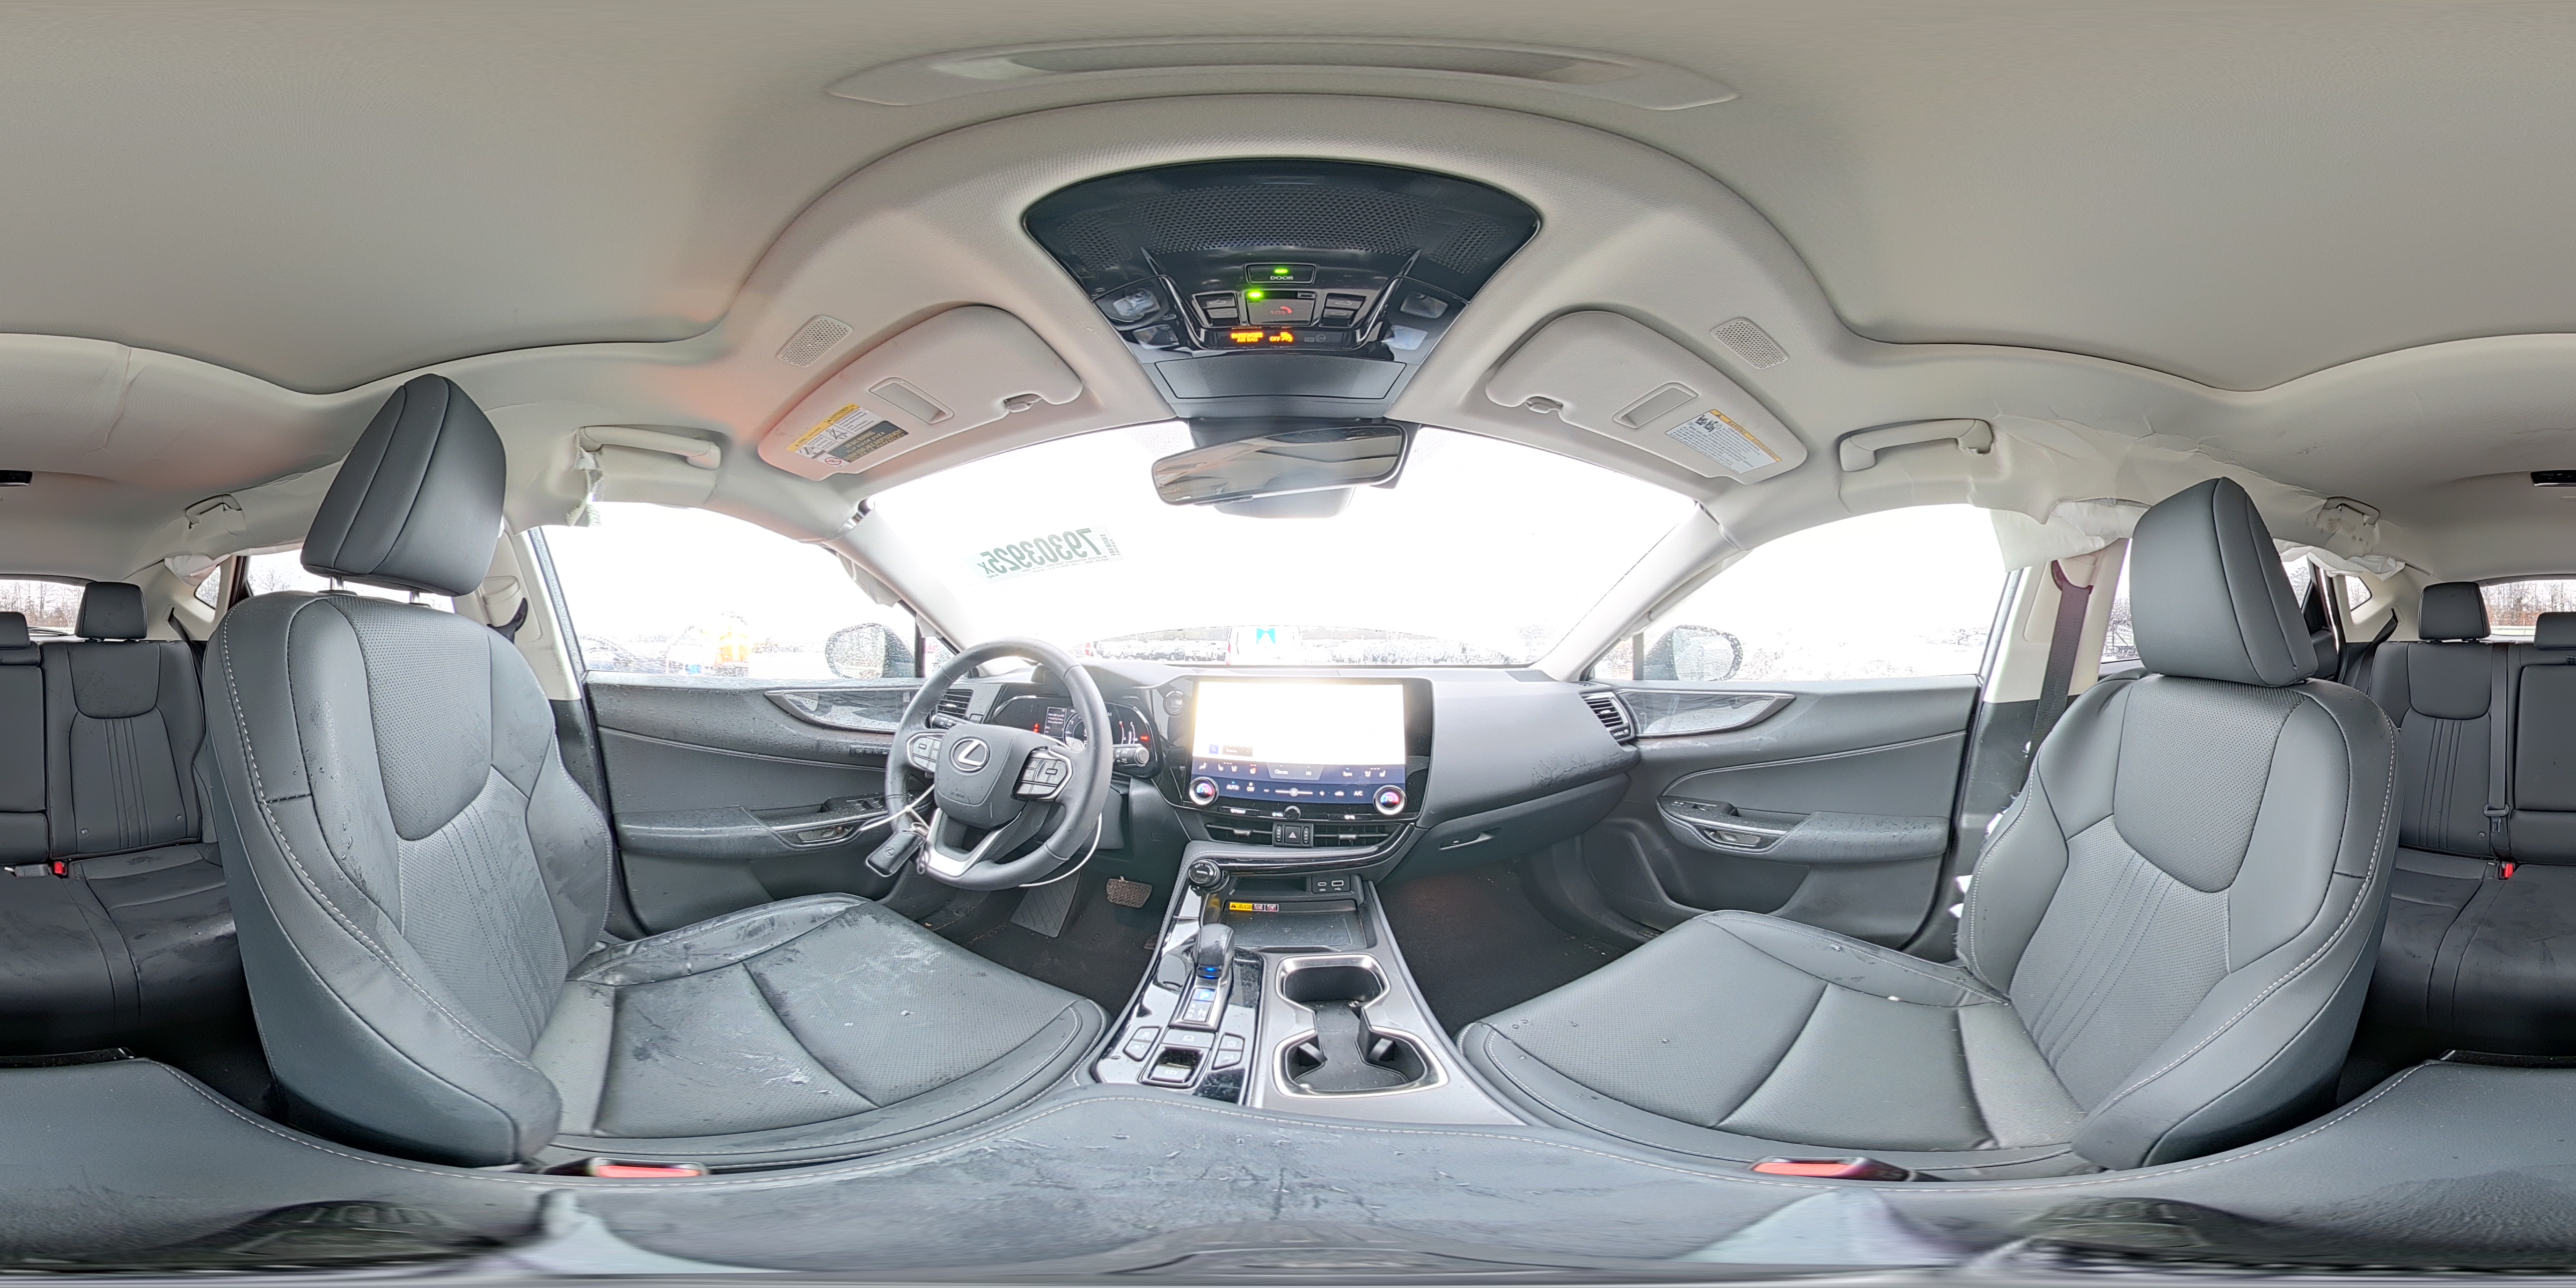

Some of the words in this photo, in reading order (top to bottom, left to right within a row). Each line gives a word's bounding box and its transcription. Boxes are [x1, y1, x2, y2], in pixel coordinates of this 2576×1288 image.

[856, 439, 871, 447] VISOR
[871, 431, 886, 440] OVER
[1199, 991, 1210, 1000] P
